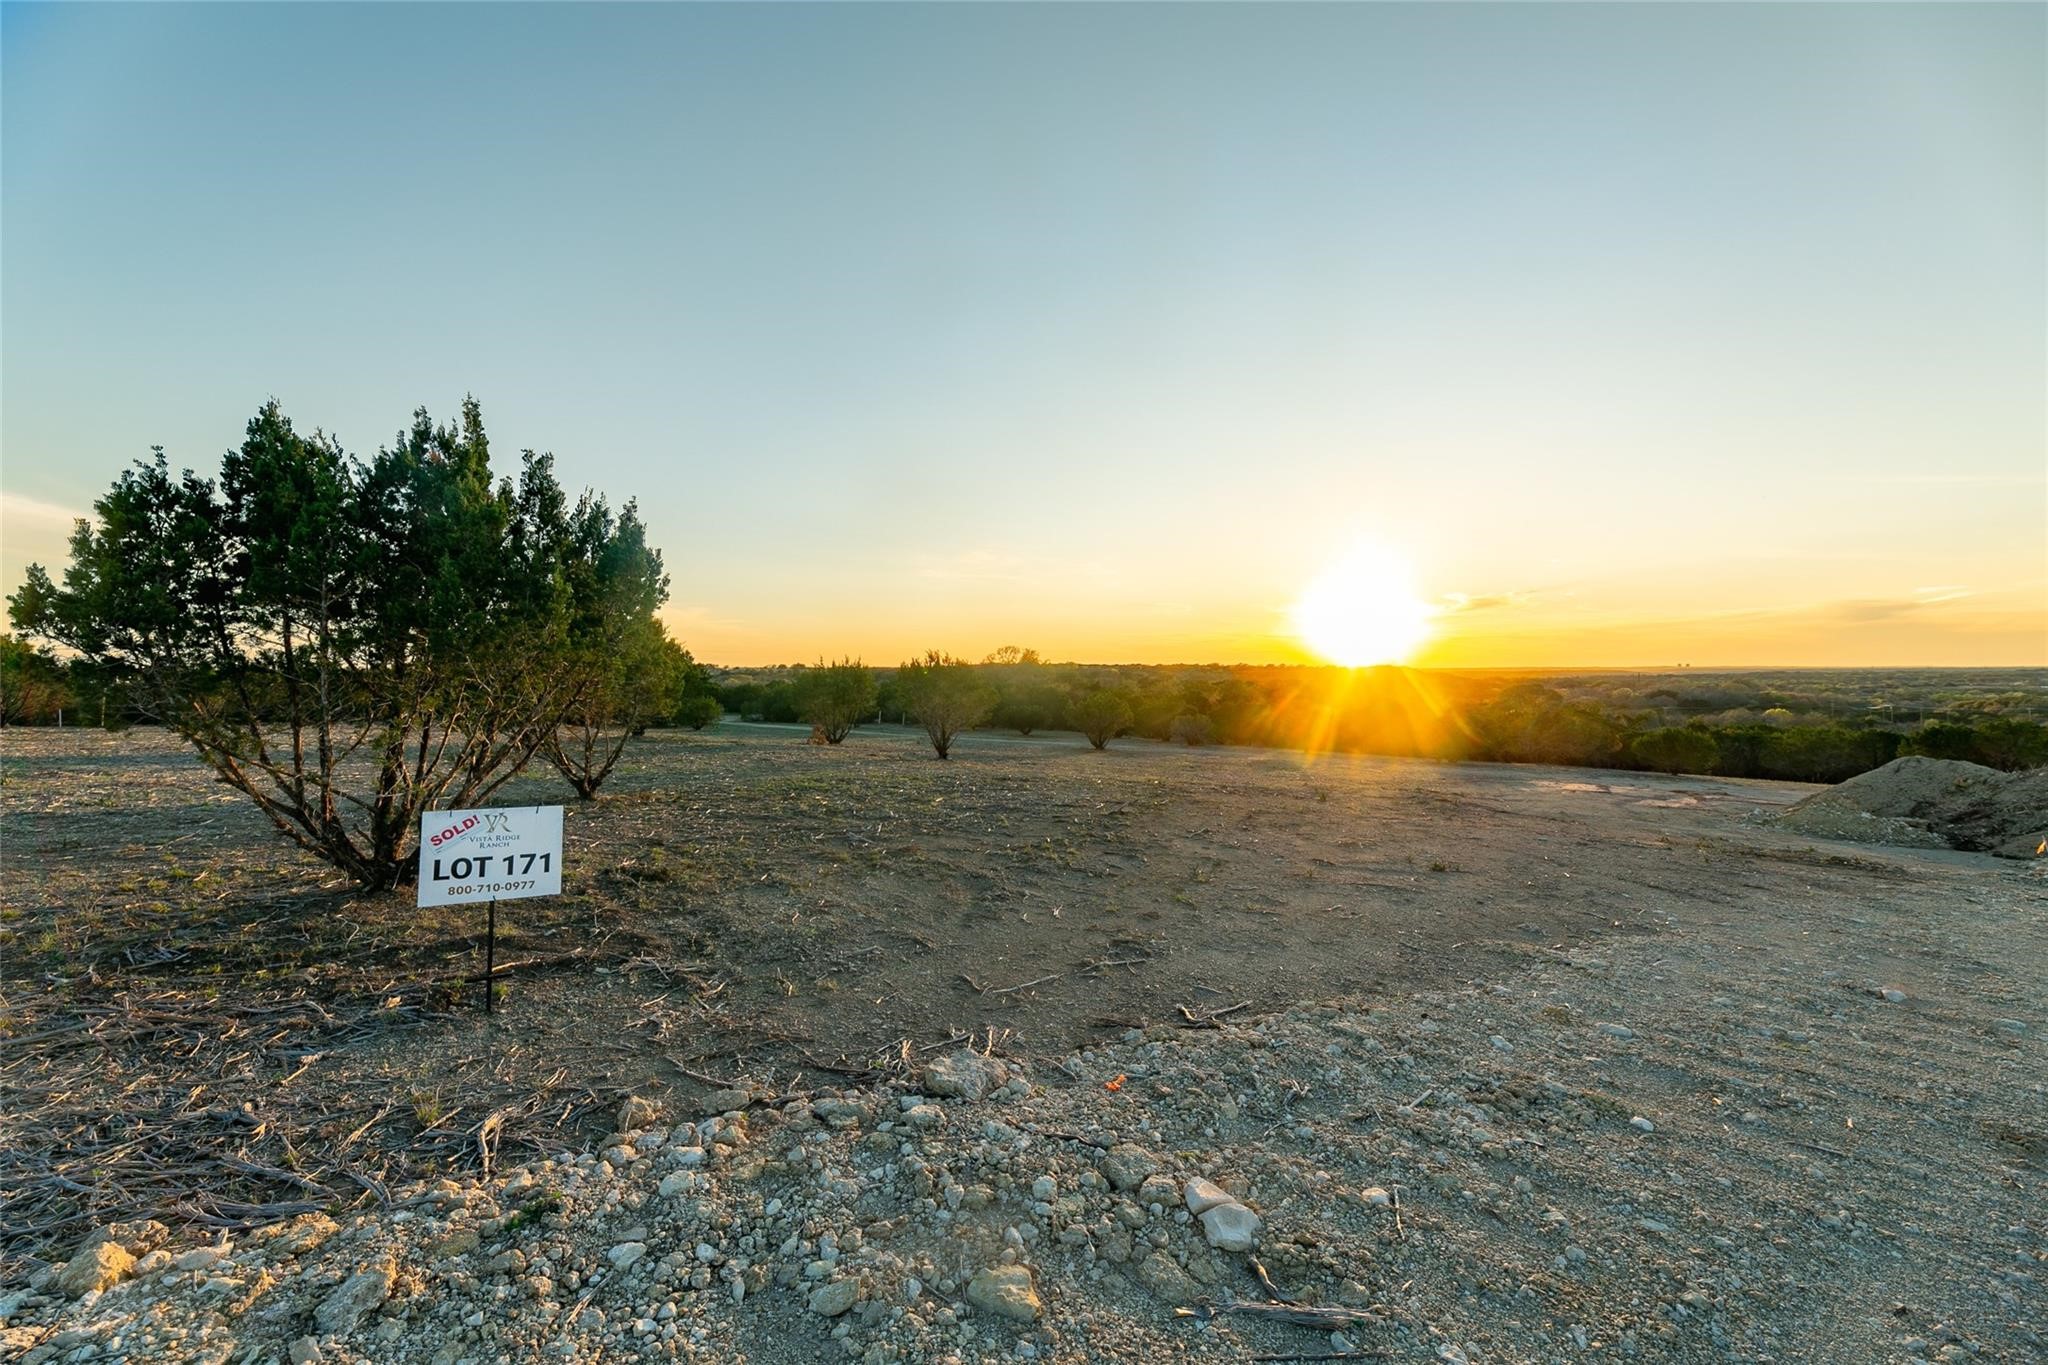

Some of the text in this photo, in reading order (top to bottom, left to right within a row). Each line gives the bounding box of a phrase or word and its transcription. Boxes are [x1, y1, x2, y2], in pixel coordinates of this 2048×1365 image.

[430, 814, 480, 846] SOLD!
[433, 852, 551, 881] LOT 171
[448, 880, 535, 896] 800-710-0977
